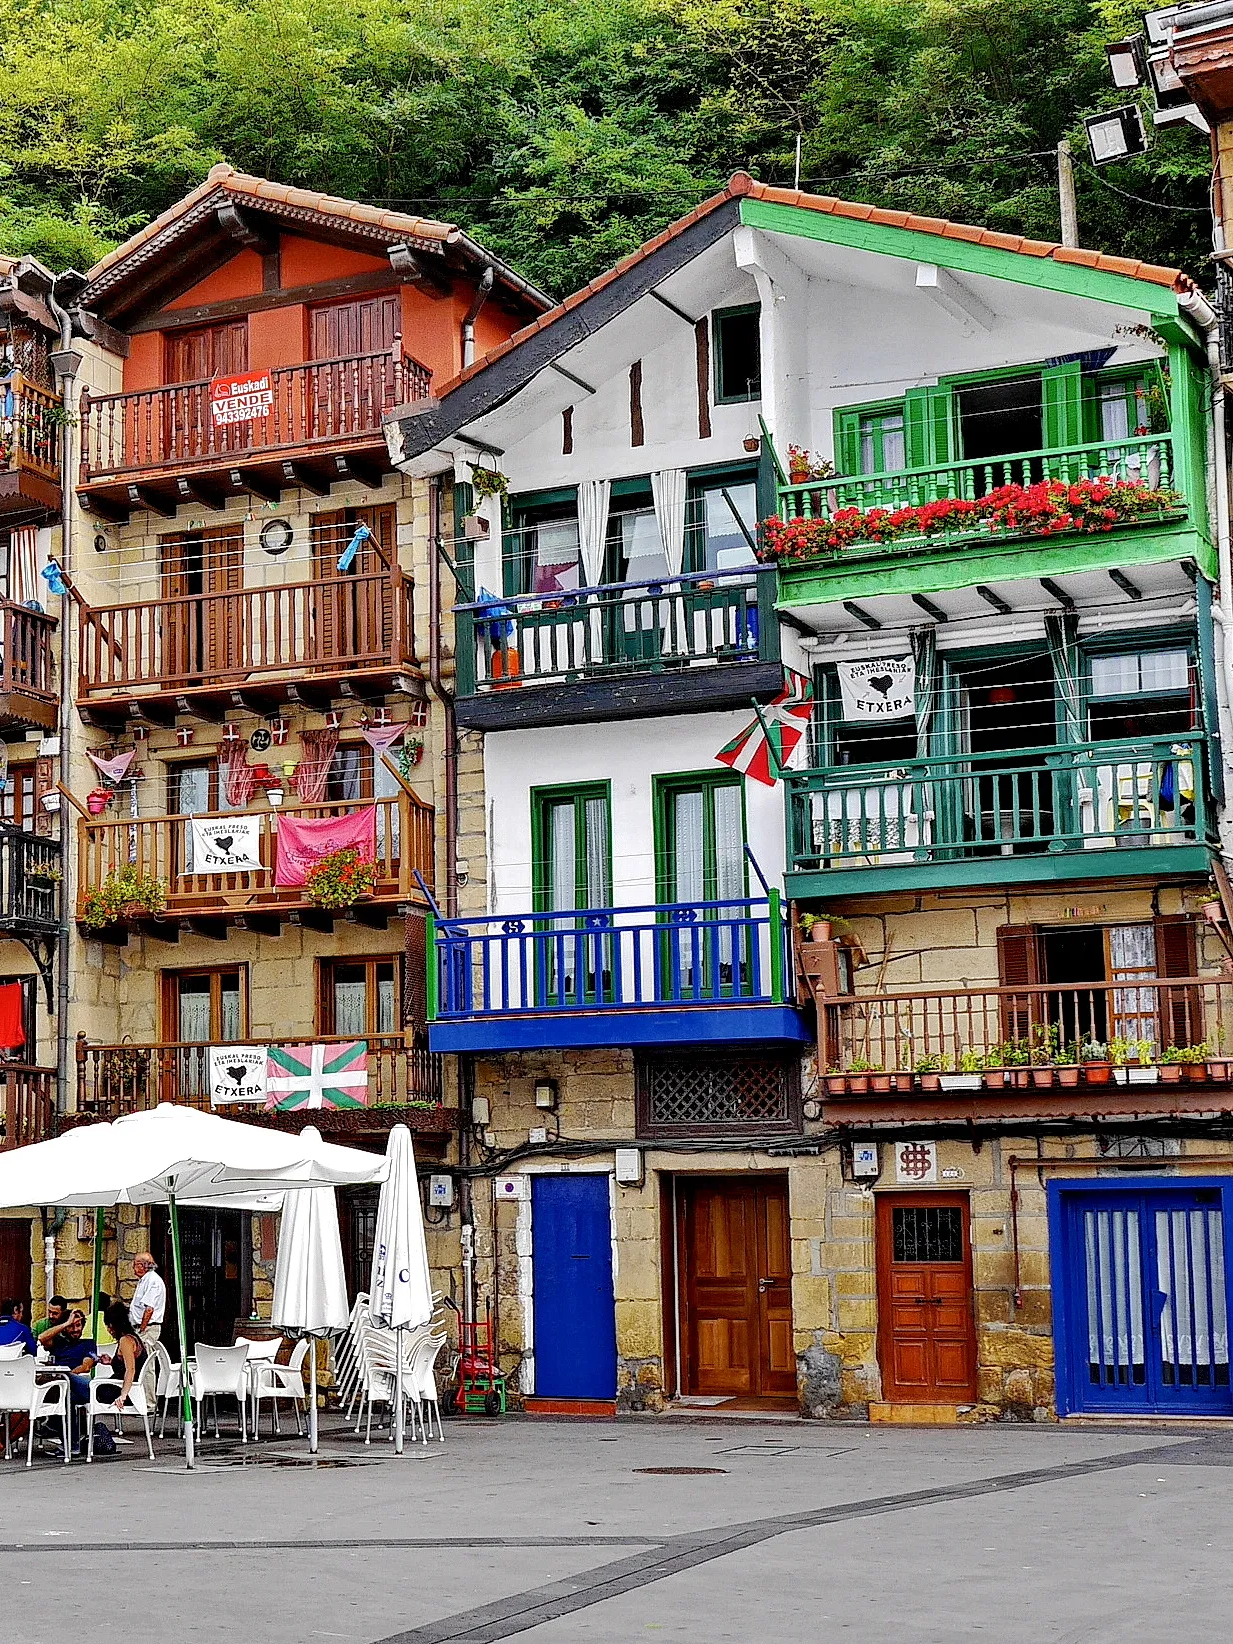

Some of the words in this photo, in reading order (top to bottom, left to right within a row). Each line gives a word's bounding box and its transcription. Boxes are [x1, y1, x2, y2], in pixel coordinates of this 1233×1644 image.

[231, 376, 269, 395] Euskadi
[215, 392, 270, 412] VENDE
[216, 405, 270, 426] 943392476
[850, 661, 882, 673] EUSKAL
[850, 671, 865, 679] ETA
[856, 695, 913, 713] ETXERA
[204, 853, 250, 865] ETXERA
[214, 1084, 263, 1097] ETXERA
